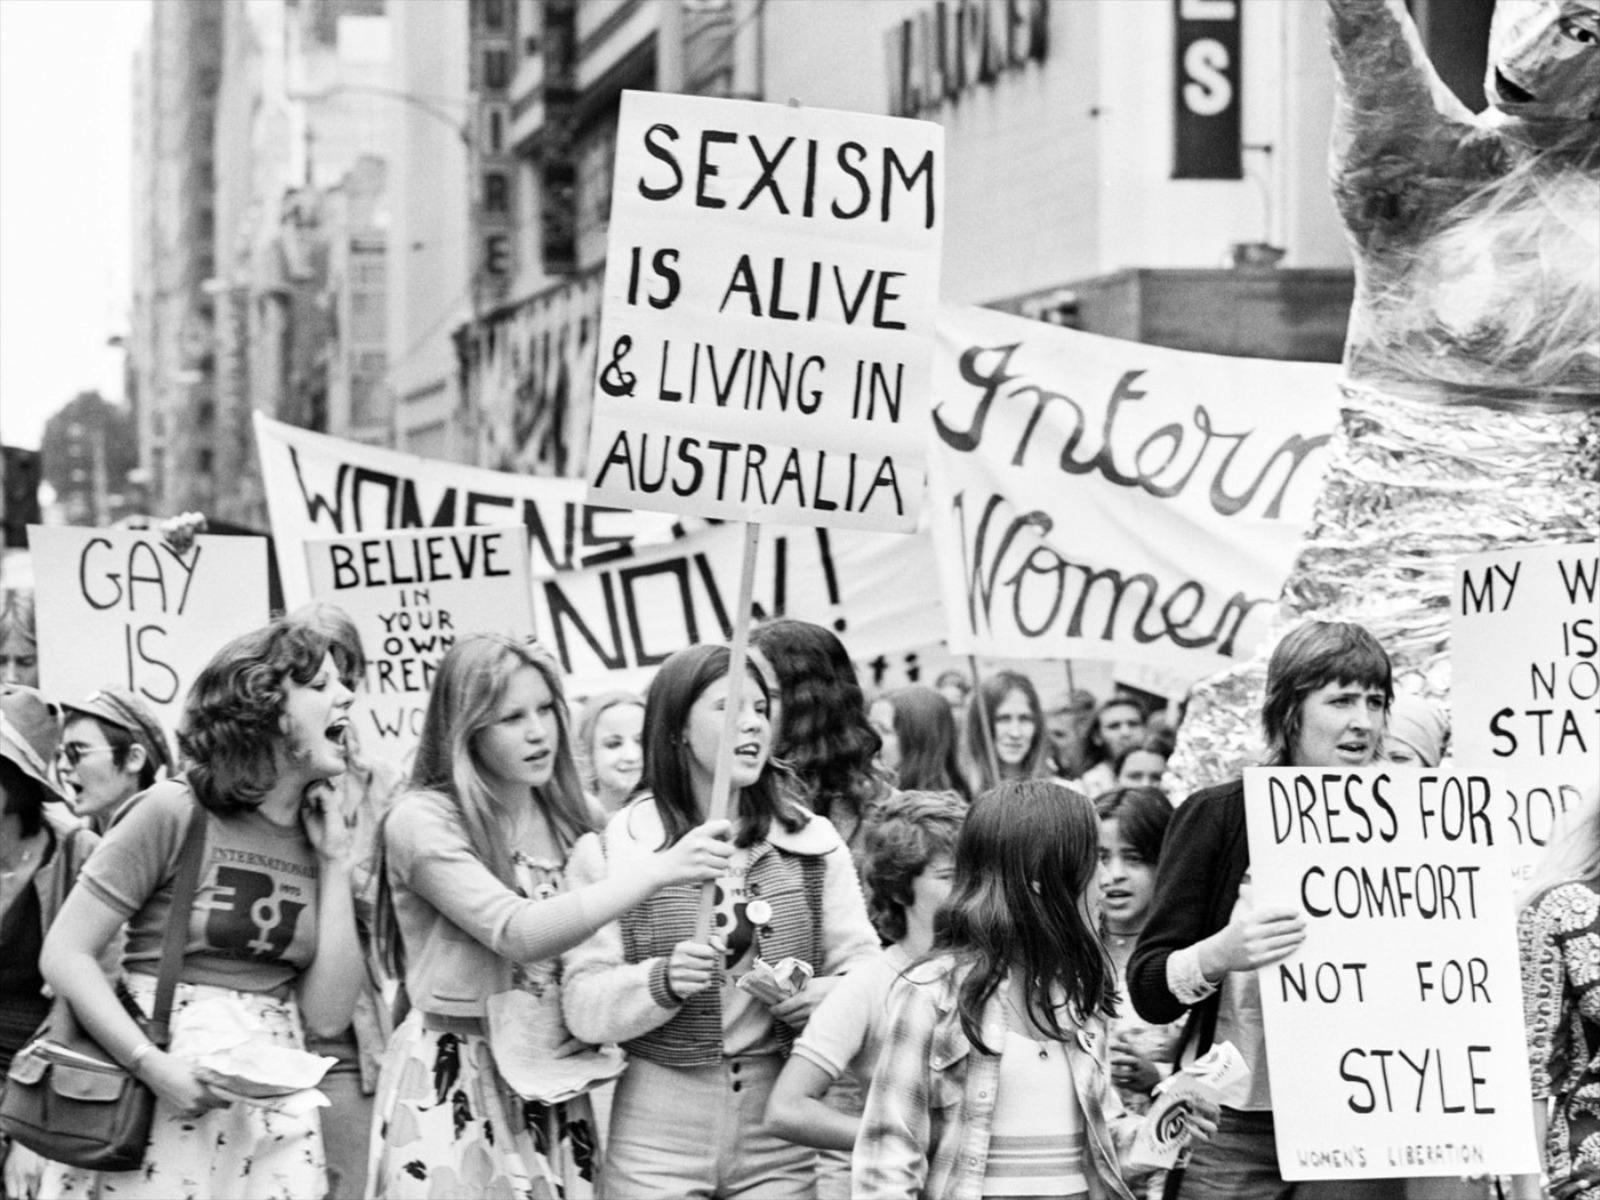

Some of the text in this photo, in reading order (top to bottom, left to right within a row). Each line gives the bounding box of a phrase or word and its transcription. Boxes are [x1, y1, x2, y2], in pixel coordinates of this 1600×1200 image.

[638, 123, 935, 229] SEXISM
[627, 246, 907, 330] IS ALIVE
[599, 334, 905, 423] & LIVING IN
[593, 430, 904, 516] AUSTRALIA
[79, 536, 202, 616] GAY
[328, 533, 511, 590] BELIEVE
[1461, 560, 1522, 616] MY
[377, 609, 455, 633] YOUR
[400, 588, 431, 608] IN
[125, 623, 181, 704] IS
[383, 635, 456, 656] OWN
[1563, 618, 1598, 659] IS
[1488, 706, 1600, 758] STA
[1268, 773, 1495, 847] DRESS FOR
[1300, 864, 1481, 920] COMFORT
[1279, 957, 1493, 1005] NOT FOR
[1339, 1045, 1497, 1115] STYLE
[1388, 1144, 1485, 1166] LIBERATION
